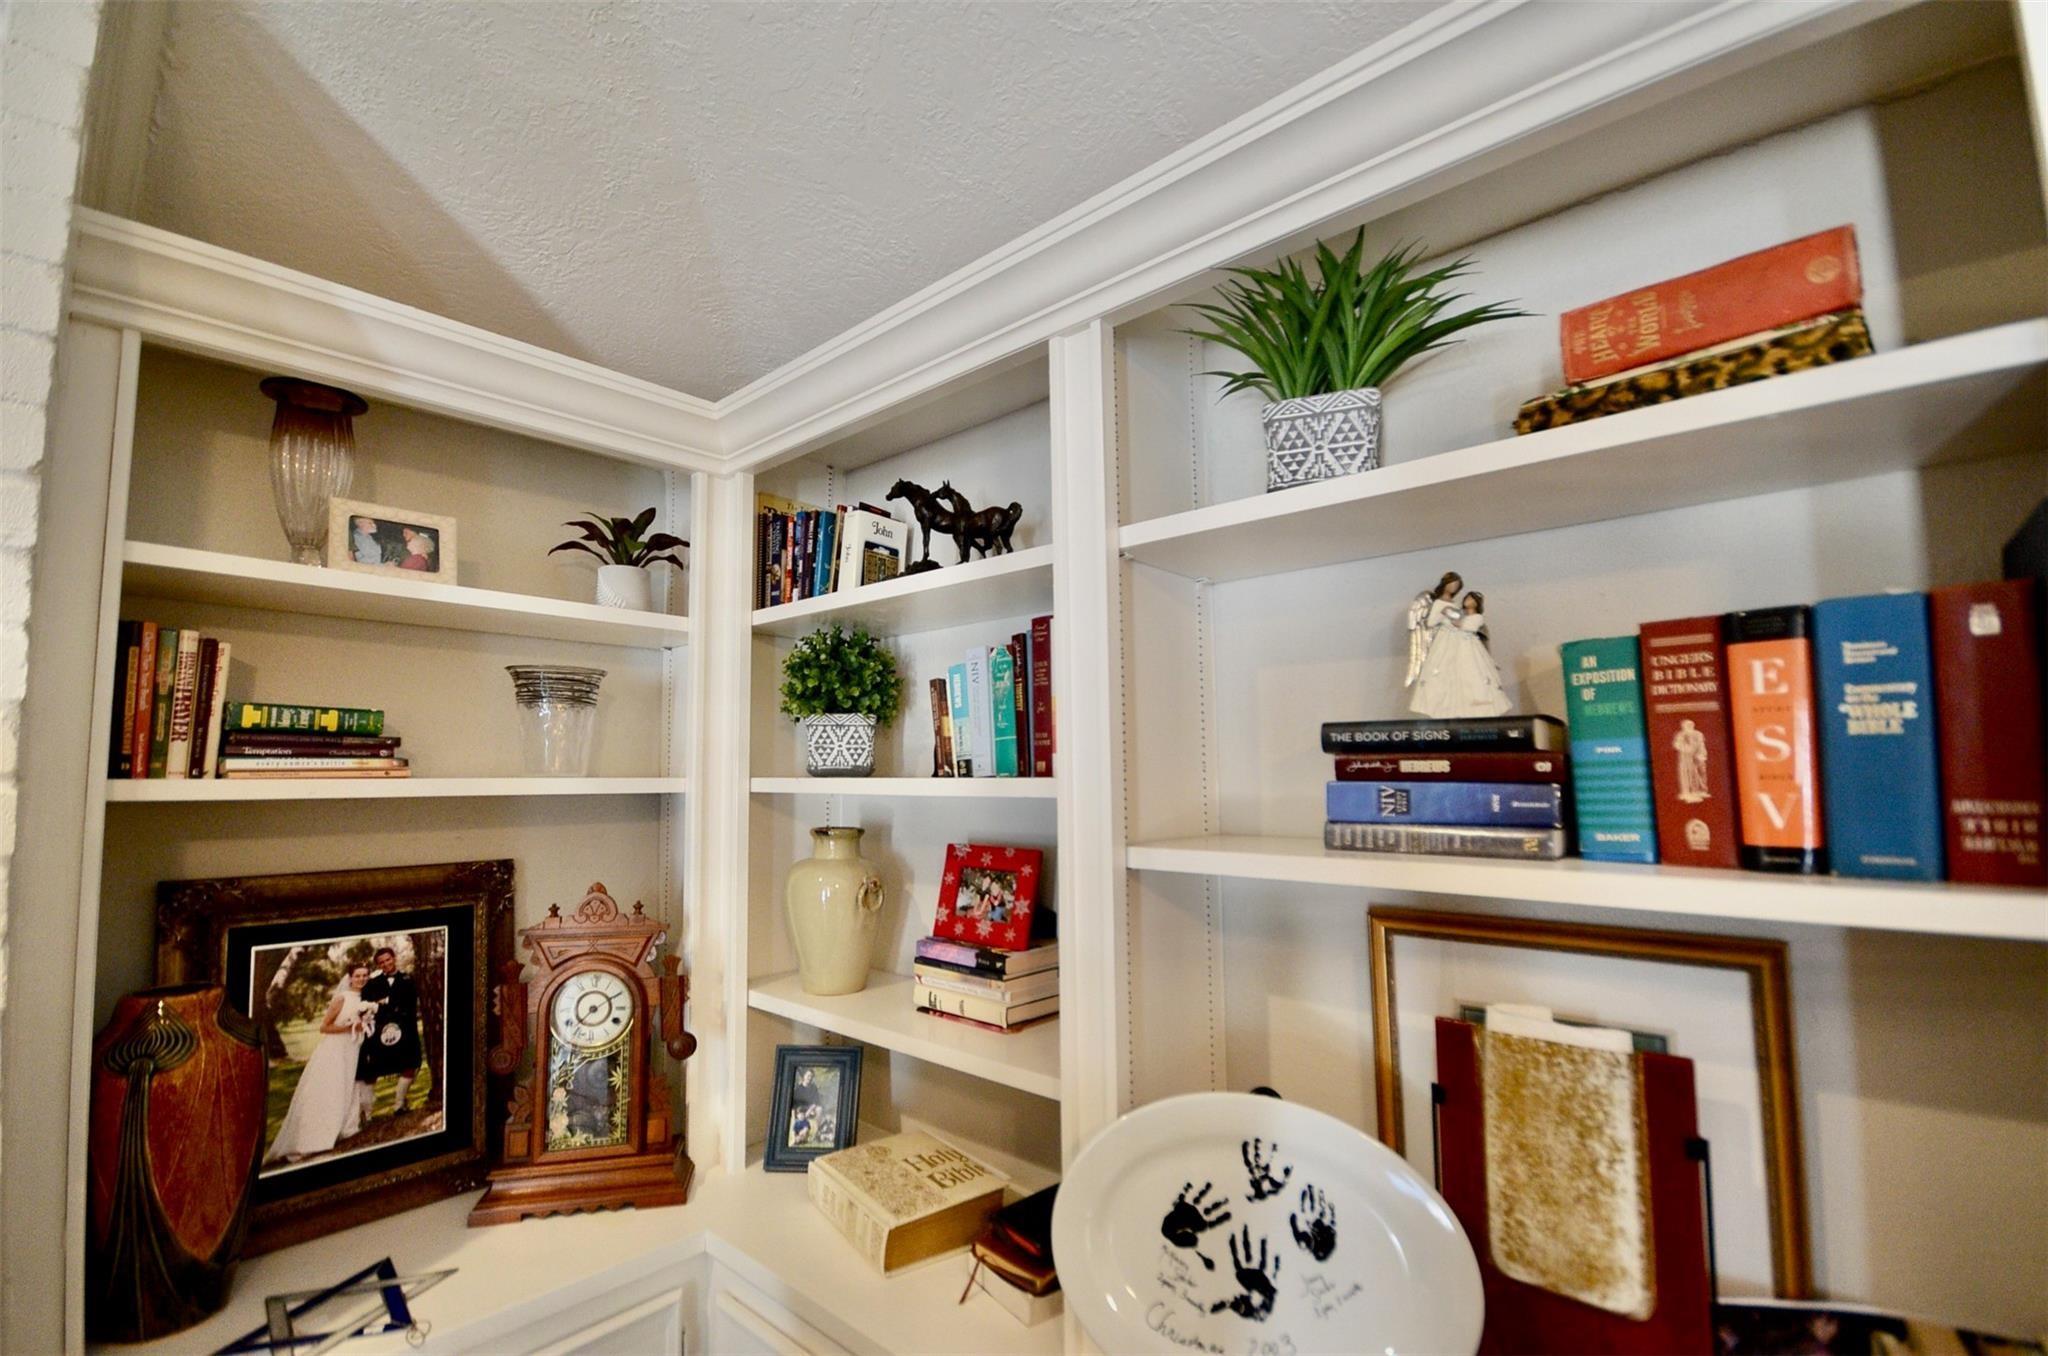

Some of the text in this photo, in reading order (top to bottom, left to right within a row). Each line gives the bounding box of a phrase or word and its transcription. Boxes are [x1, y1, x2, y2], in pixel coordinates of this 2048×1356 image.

[872, 521, 894, 539] John
[1581, 655, 1597, 669] AN
[971, 661, 980, 684] NIV
[1571, 668, 1636, 686] EXPOSITION
[1652, 666, 1716, 681] BIBLE
[1582, 688, 1597, 702] OF
[1651, 681, 1718, 696] DICTIONARY
[1330, 729, 1451, 743] THE BOOK OF SIGNS
[1380, 785, 1396, 817] NIV
[902, 1149, 969, 1172] Holy
